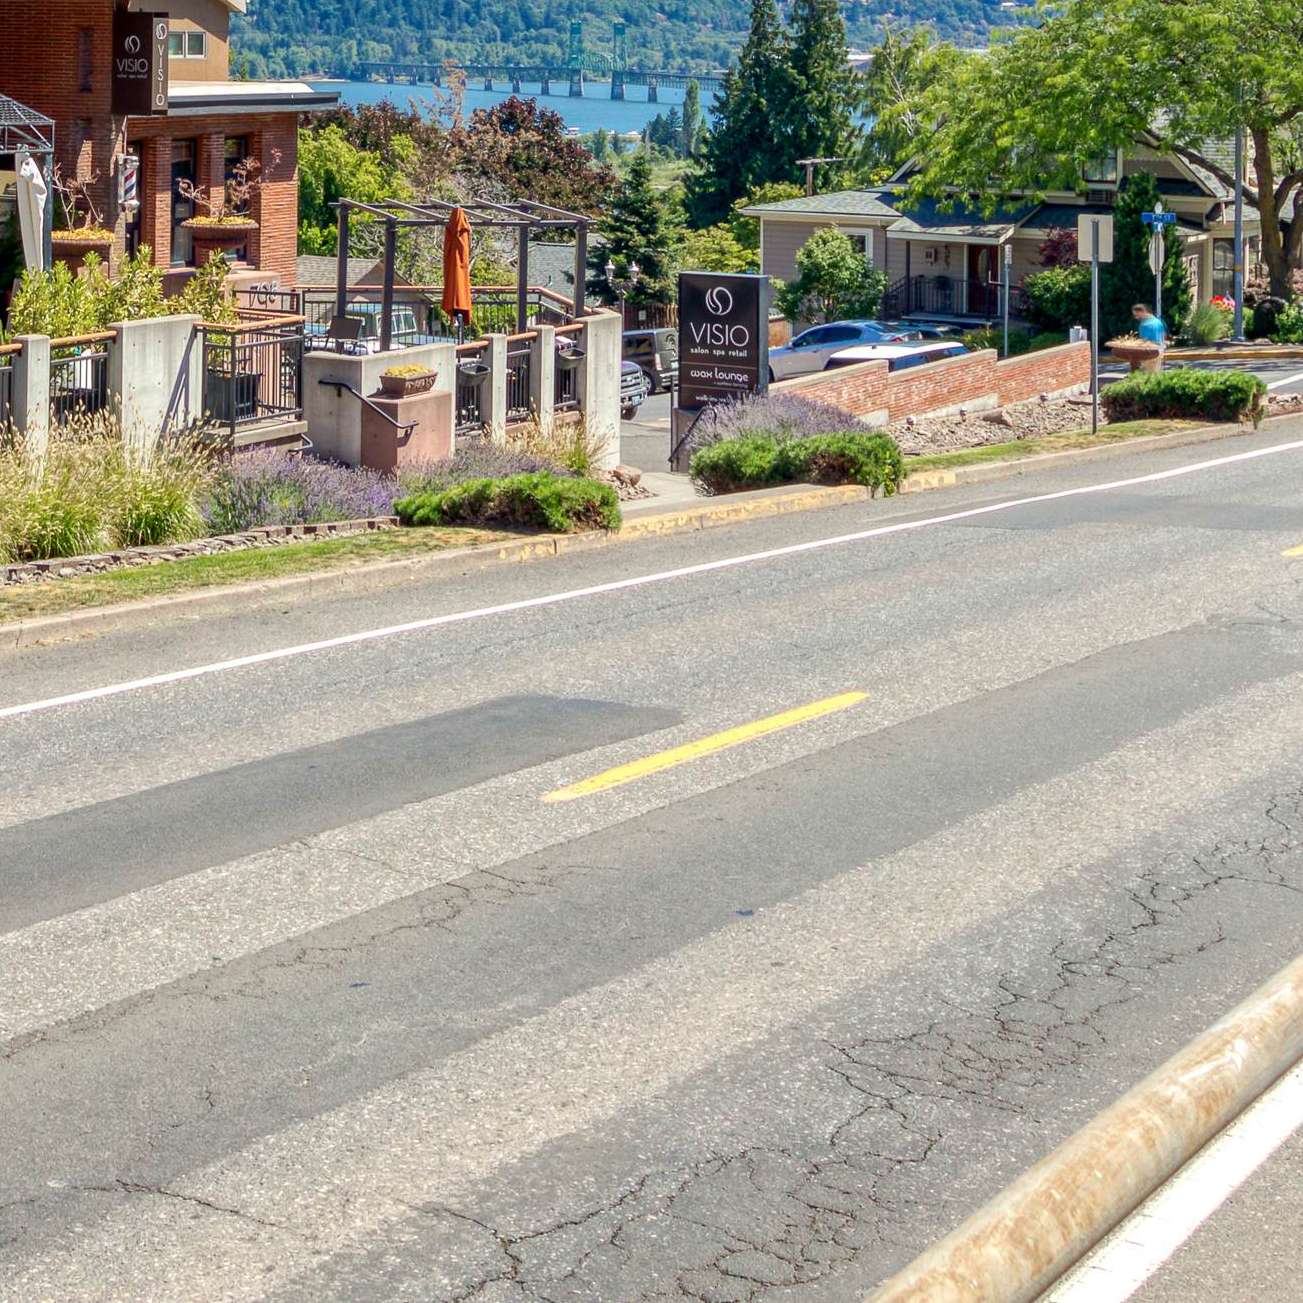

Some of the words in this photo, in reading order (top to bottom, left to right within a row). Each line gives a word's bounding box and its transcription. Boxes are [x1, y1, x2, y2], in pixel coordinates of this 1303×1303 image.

[117, 58, 148, 73] VISIO
[156, 43, 165, 106] VISIO
[690, 321, 749, 347] VISIO
[713, 349, 725, 357] spa
[729, 349, 747, 357] retail
[690, 369, 712, 377] wax
[715, 367, 749, 382] lounge
